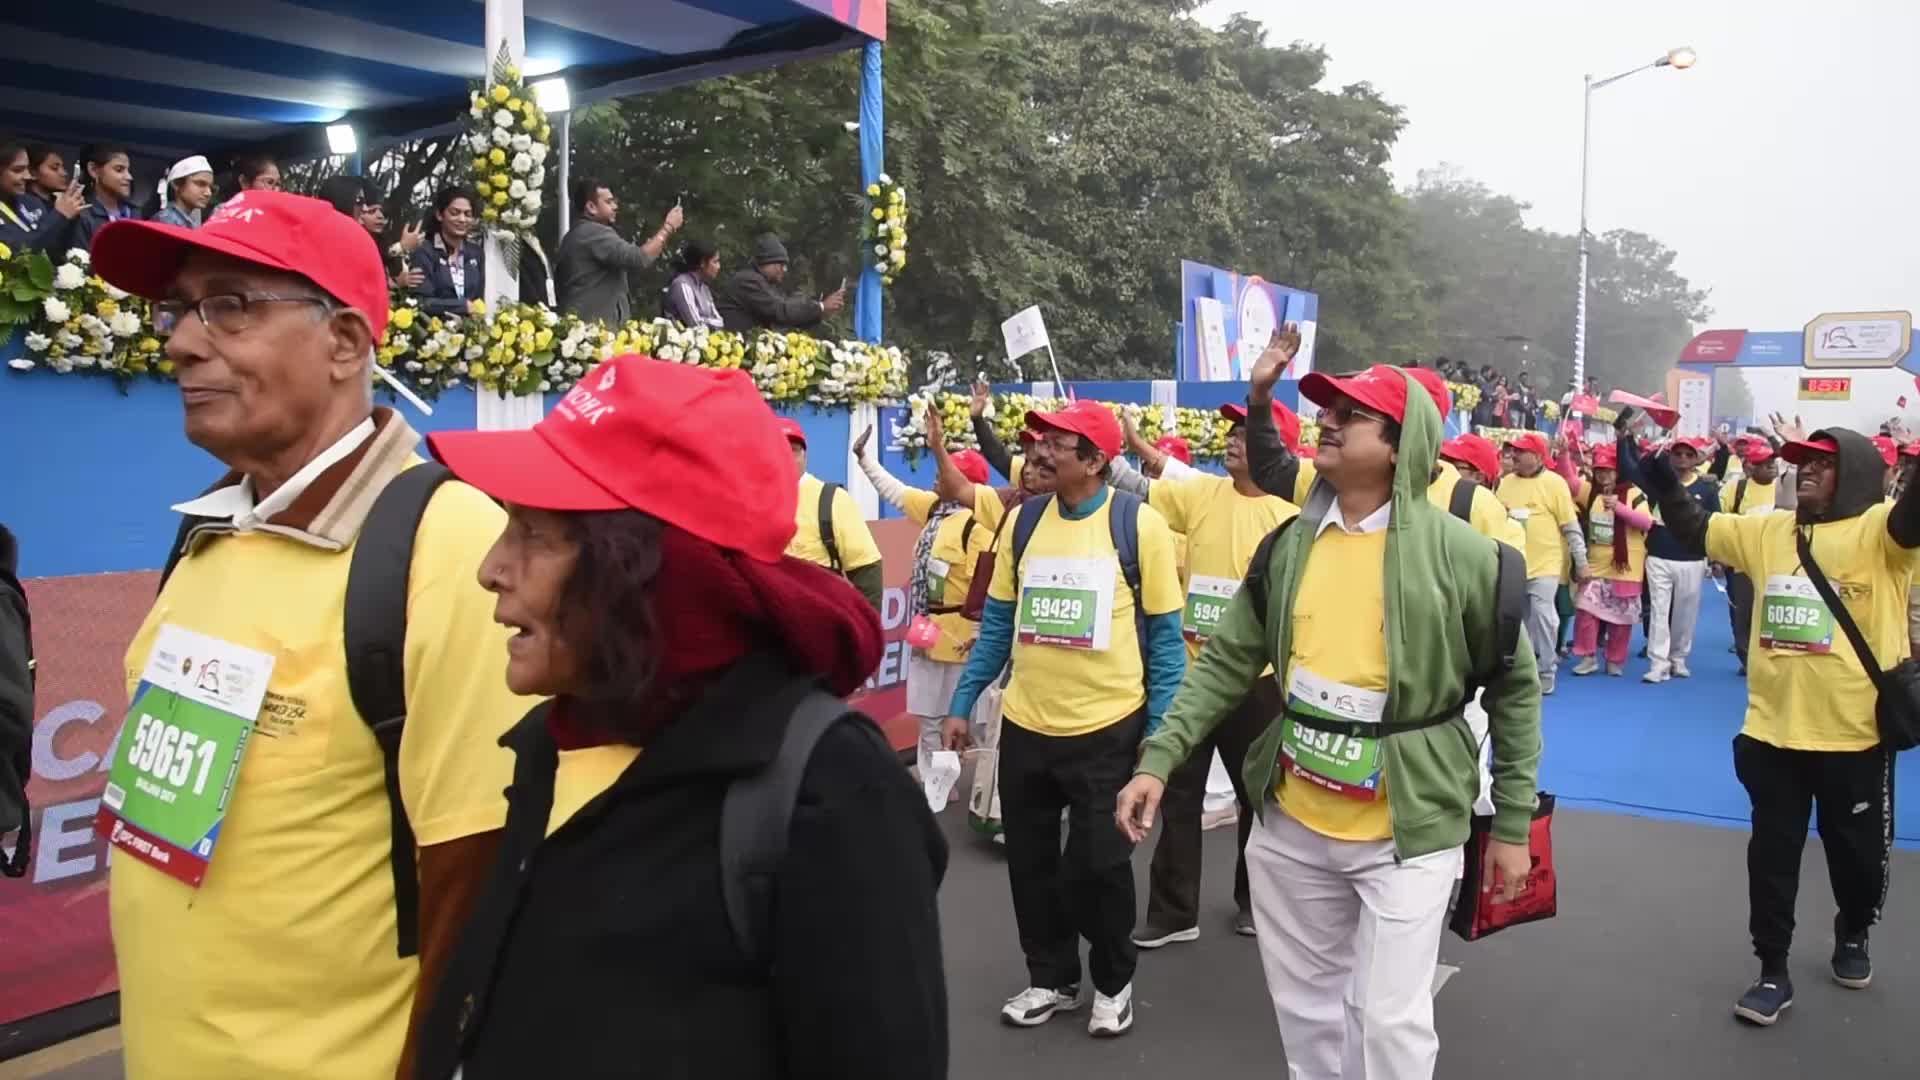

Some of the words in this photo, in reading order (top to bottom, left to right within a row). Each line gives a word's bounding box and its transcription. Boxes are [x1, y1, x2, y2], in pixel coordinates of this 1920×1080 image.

[1031, 597, 1083, 620] 59429
[1767, 604, 1820, 626] 60362
[128, 713, 217, 796] 59651
